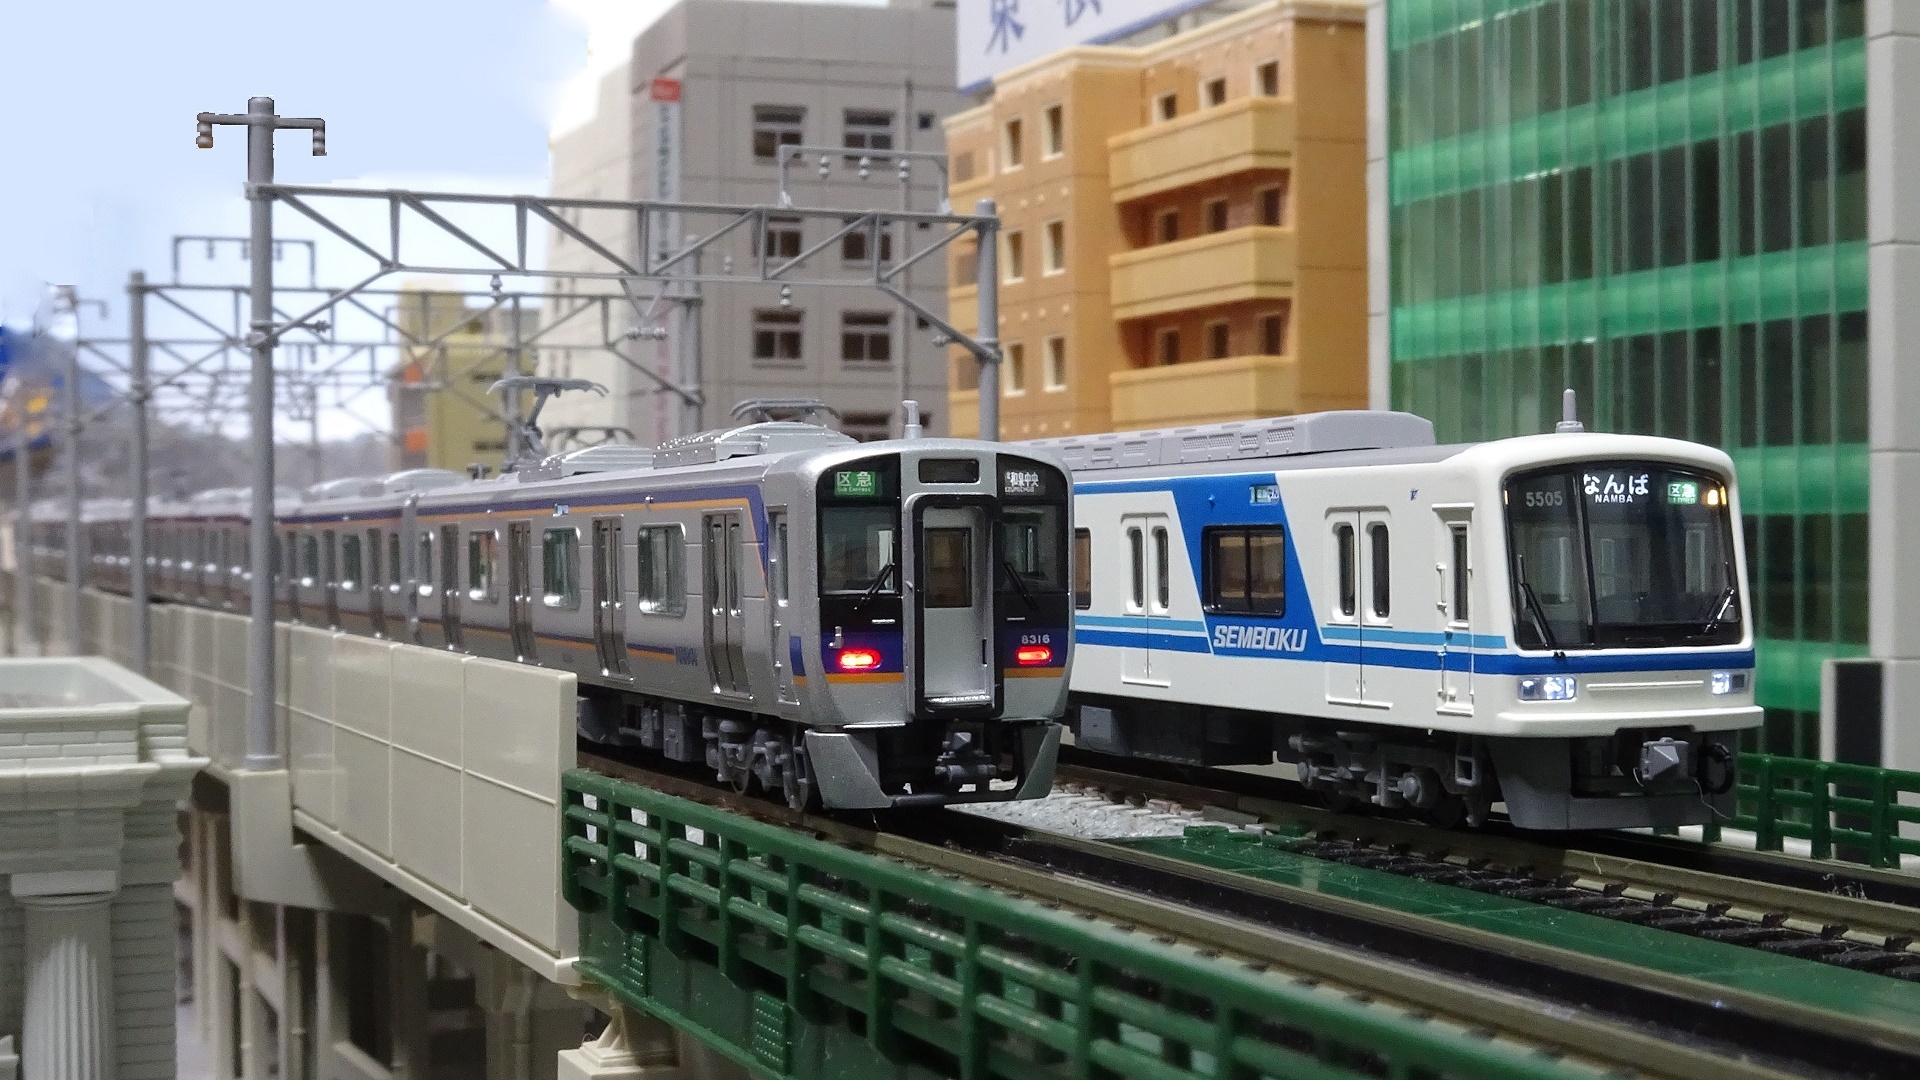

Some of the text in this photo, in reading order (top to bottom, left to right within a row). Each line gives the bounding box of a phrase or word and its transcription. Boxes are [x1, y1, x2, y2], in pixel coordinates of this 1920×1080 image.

[836, 471, 872, 487] 区急
[1583, 473, 1649, 495] なんば
[1525, 490, 1563, 507] 5505
[1594, 494, 1634, 503] NAMBA
[1021, 634, 1050, 644] 8316
[1213, 624, 1308, 652] SEMBOKU
